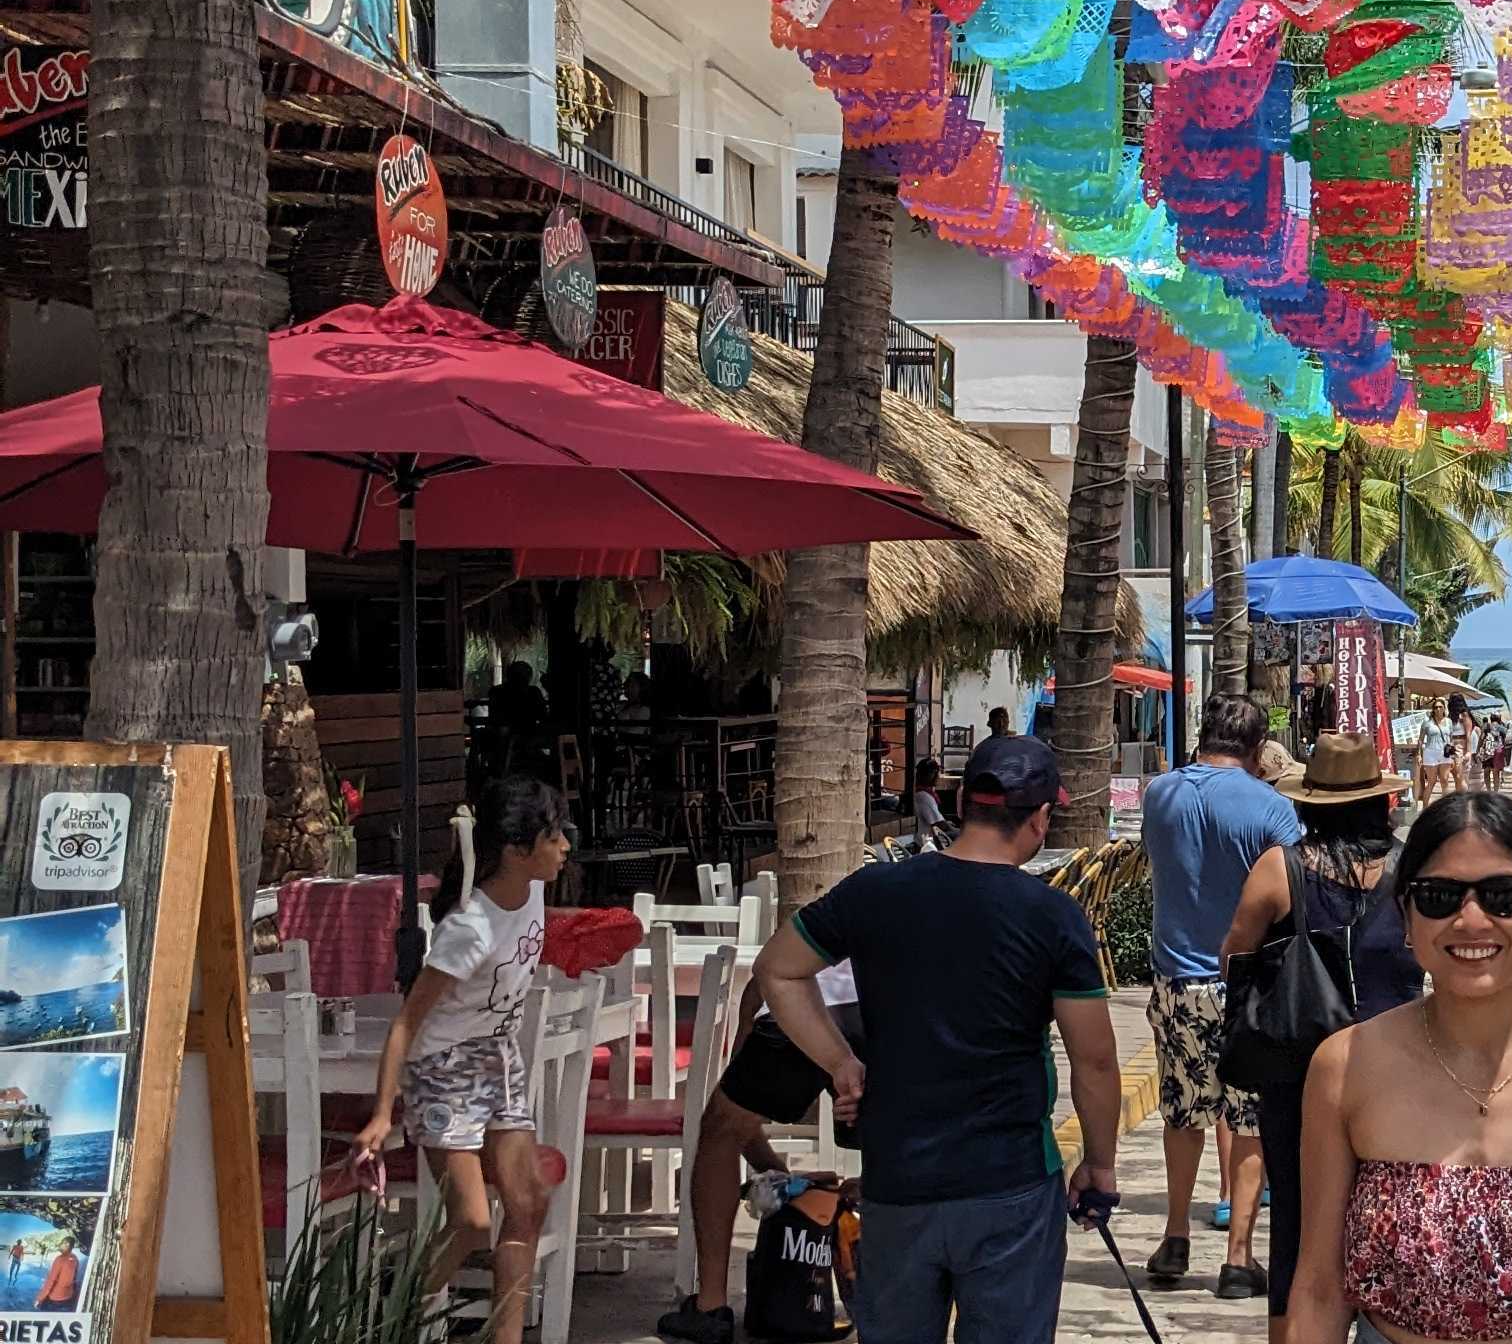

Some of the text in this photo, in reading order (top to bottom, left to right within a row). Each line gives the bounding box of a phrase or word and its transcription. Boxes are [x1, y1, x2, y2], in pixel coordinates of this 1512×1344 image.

[40, 123, 71, 149] the
[380, 144, 430, 206] Ruben
[410, 207, 436, 238] FOR
[401, 233, 439, 293] HOME
[69, 807, 102, 822] BEST
[45, 865, 110, 880] tripadvisor
